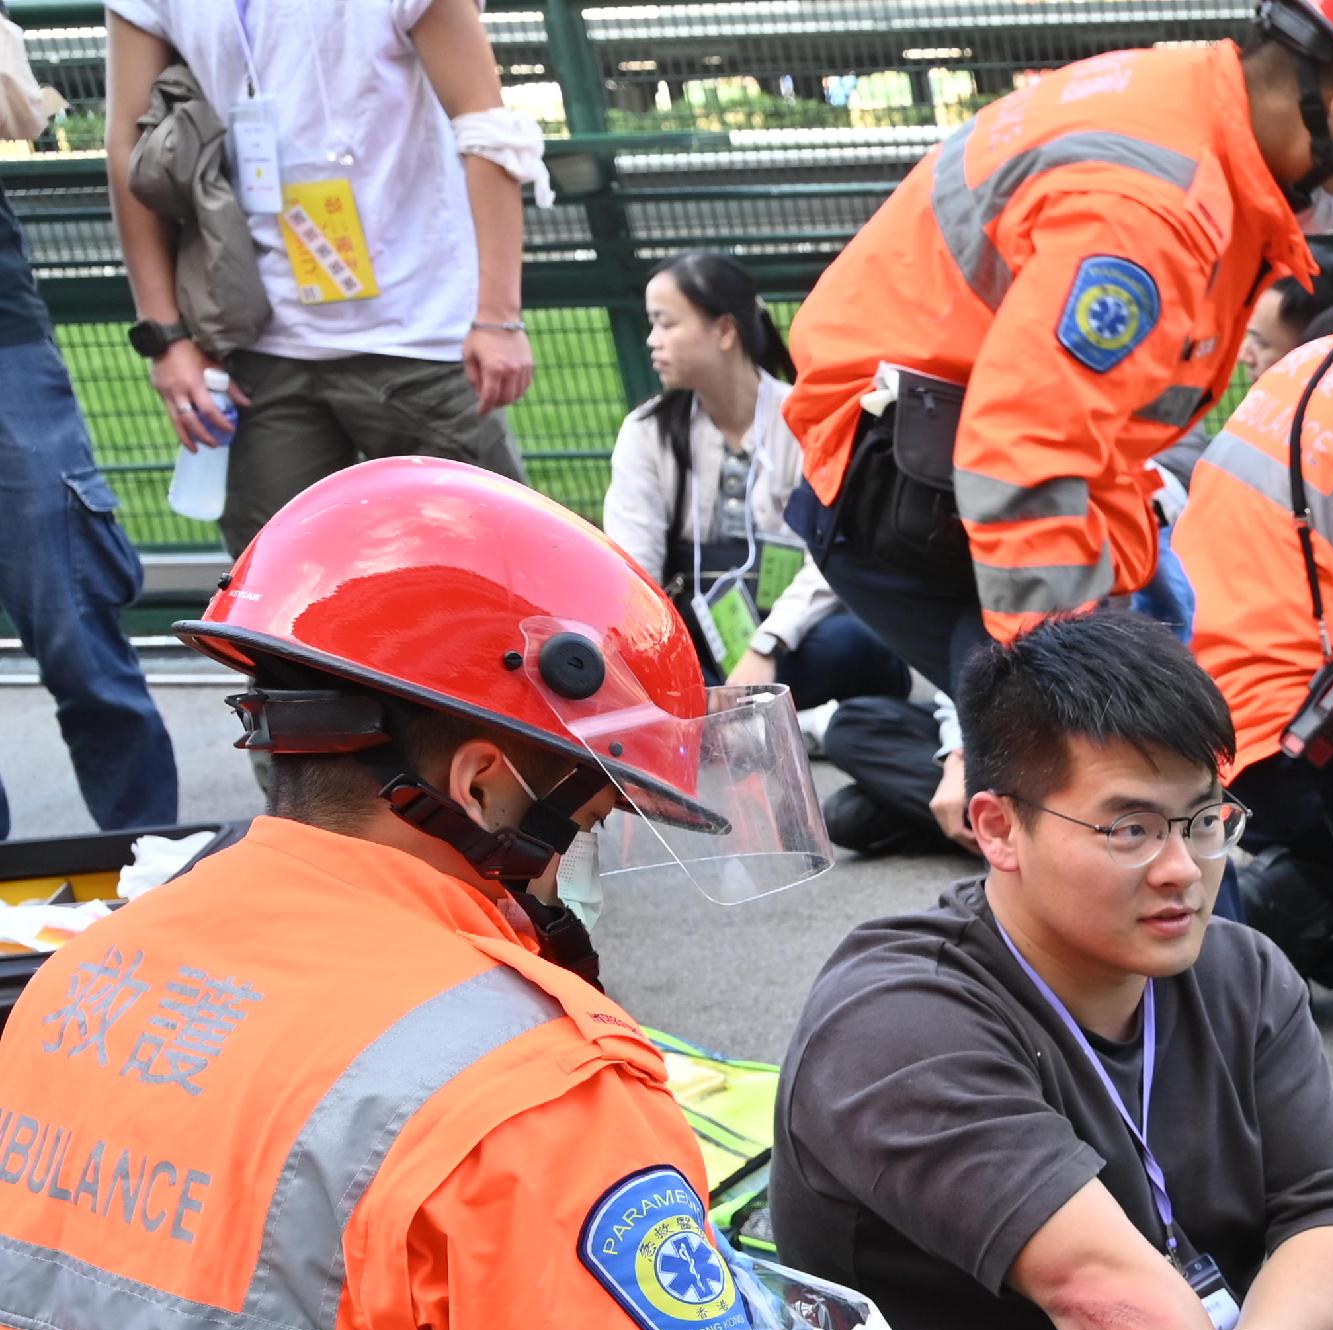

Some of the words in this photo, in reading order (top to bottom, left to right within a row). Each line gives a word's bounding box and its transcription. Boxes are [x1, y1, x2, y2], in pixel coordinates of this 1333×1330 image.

[42, 944, 264, 1097] 救護
[696, 1298, 730, 1320] 香港
[723, 1313, 746, 1329] KONG
